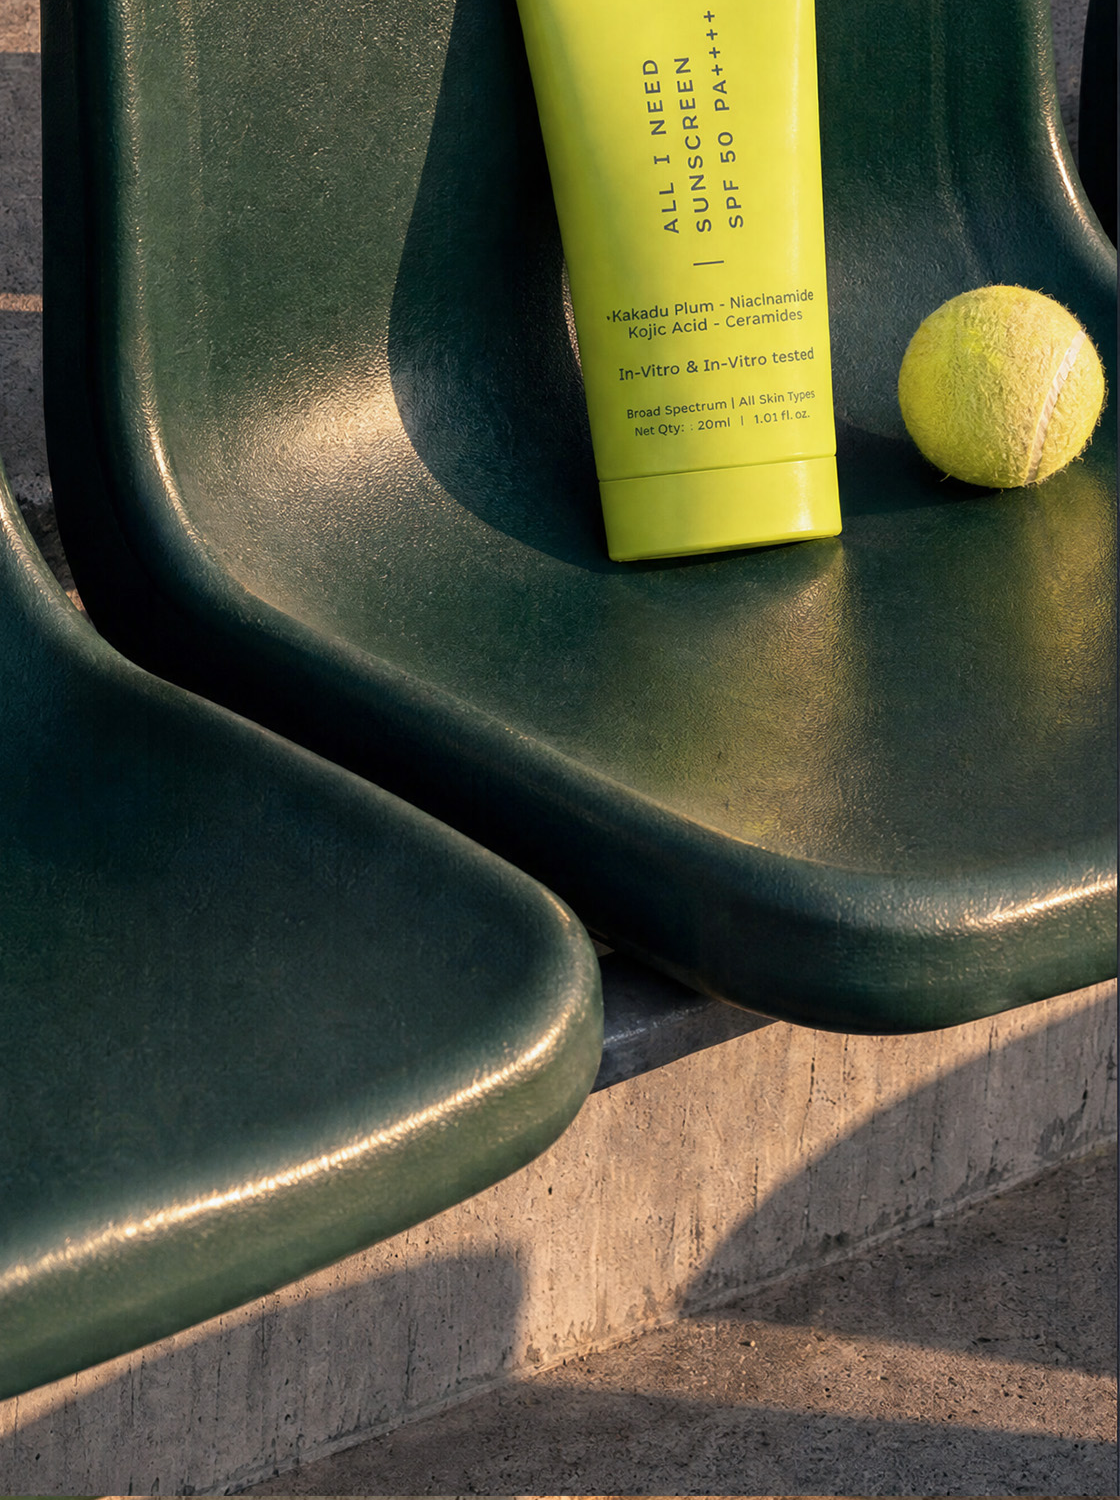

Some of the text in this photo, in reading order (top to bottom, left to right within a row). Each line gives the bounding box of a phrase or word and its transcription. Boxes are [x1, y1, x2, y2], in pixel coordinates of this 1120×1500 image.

[642, 60, 679, 234] ALL I NEED
[674, 57, 712, 232] SUNSCREEN
[718, 132, 736, 163] 50
[723, 180, 744, 228] SPF
[675, 302, 714, 316] Plum
[730, 289, 814, 309] Niacinamide
[629, 323, 667, 340] Kojic
[672, 318, 707, 334] Acid
[726, 309, 803, 328] Ceramides
[619, 347, 814, 381] In-Vitro & In-Vitro tested
[627, 406, 661, 419] Broad
[665, 401, 727, 417] Spectrum
[739, 395, 755, 407] All
[759, 393, 785, 404] Skin
[787, 390, 815, 404] Types
[635, 426, 655, 436] Net
[658, 424, 684, 436] Qty:
[698, 417, 730, 430] 20ml
[754, 413, 778, 424] 1.01
